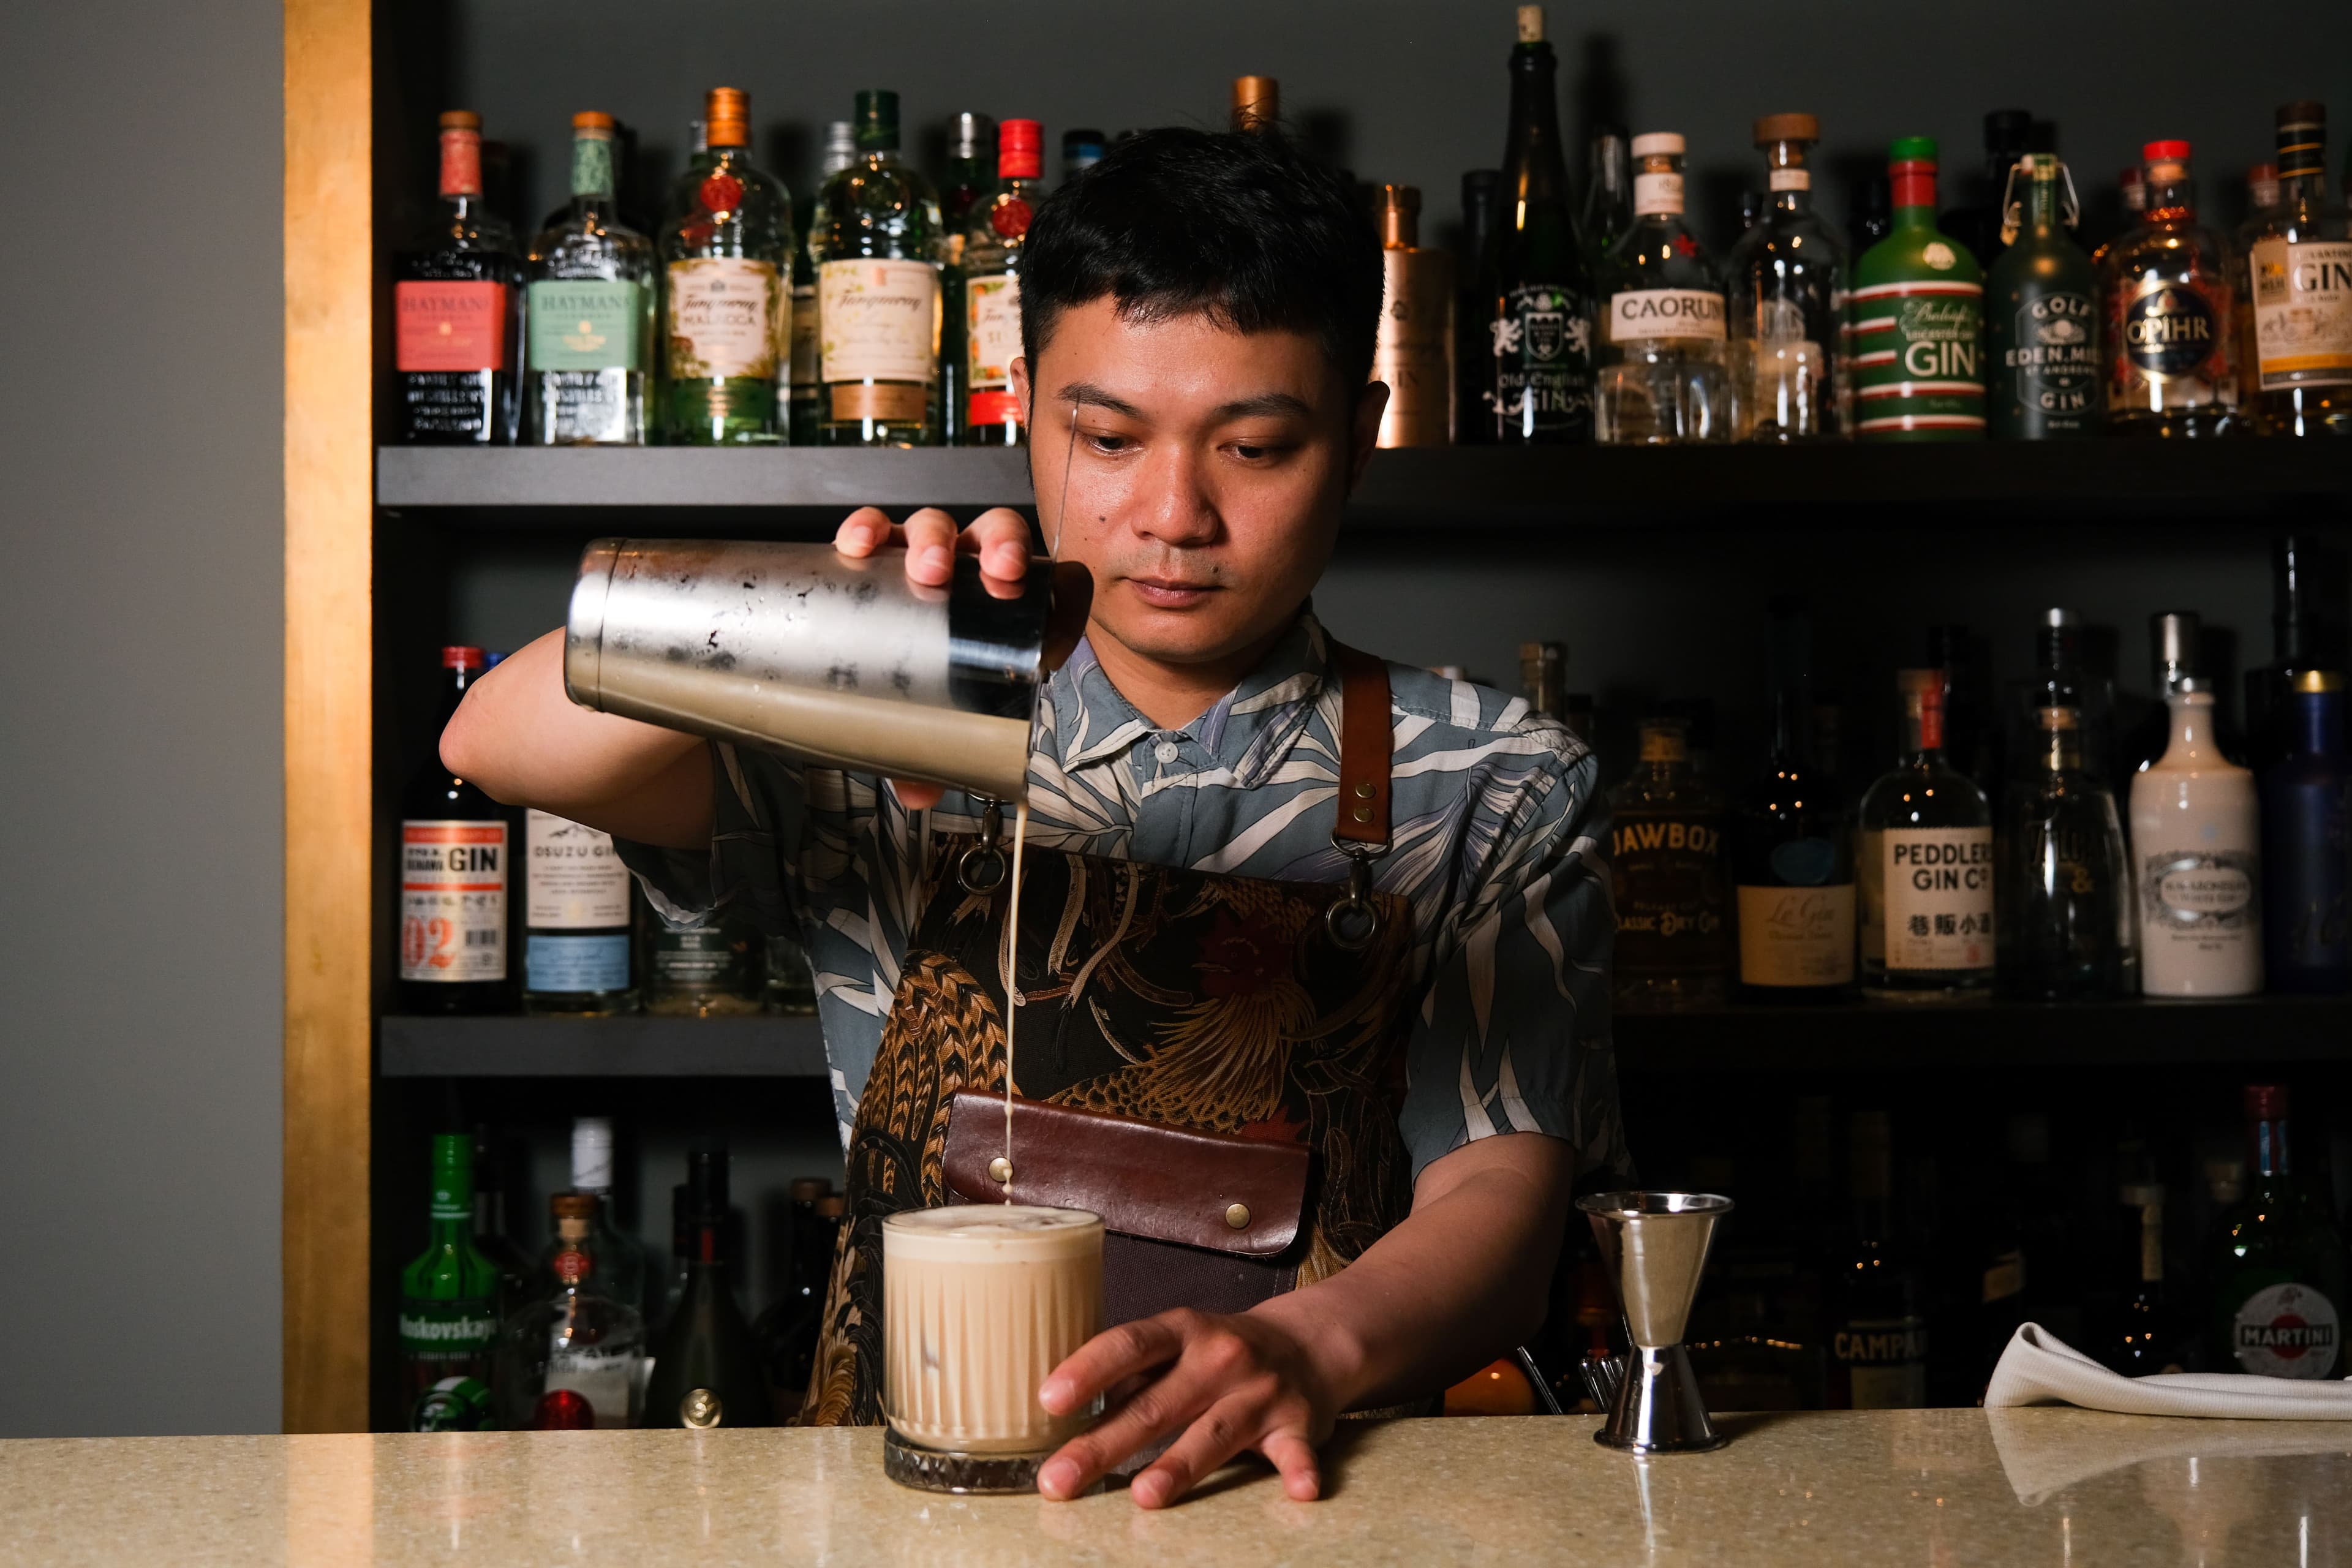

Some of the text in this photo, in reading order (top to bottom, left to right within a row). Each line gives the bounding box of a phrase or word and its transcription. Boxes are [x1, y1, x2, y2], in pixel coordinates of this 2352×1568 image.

[2293, 262, 2352, 292] GIN
[839, 288, 922, 311] Tanqueray
[2127, 314, 2210, 345] OPIHR
[1905, 340, 1976, 377] GIN
[1499, 372, 1526, 389] Old
[2040, 391, 2084, 410] GIN
[1612, 822, 1721, 858] JAWBOX
[450, 848, 497, 872] GIN
[1913, 869, 1960, 891] GIN
[402, 916, 456, 970] 02
[1834, 1330, 1929, 1361] CAMPA
[2244, 1327, 2332, 1346] MARTINI
